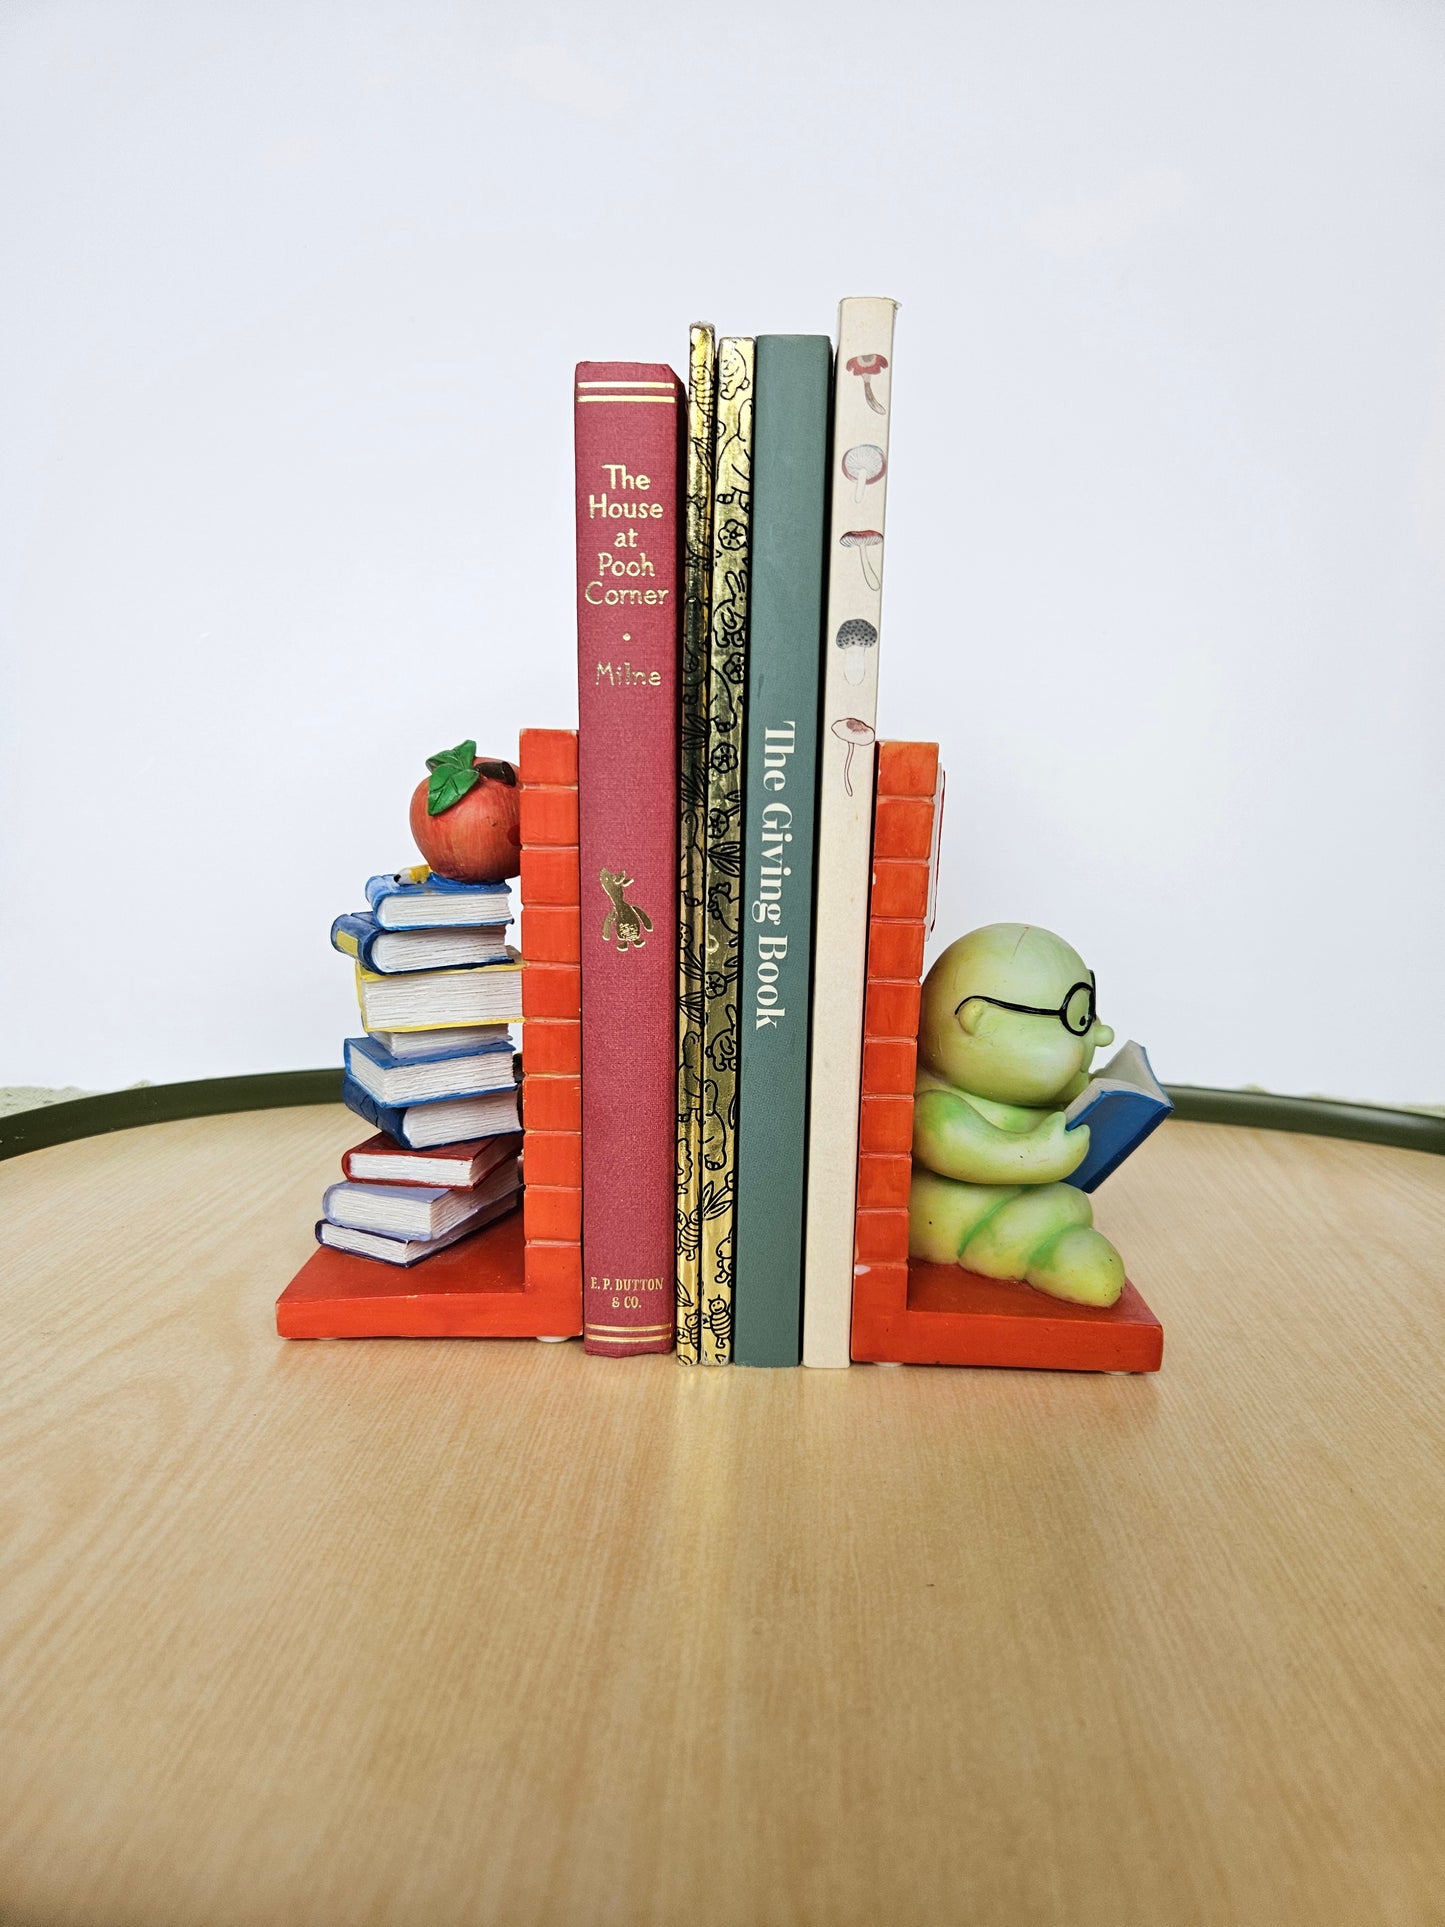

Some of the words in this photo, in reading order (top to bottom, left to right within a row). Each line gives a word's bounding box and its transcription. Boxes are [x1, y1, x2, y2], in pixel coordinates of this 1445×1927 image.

[601, 464, 650, 490] The
[588, 493, 664, 519] House
[614, 528, 638, 548] at
[598, 552, 655, 577] Pooh
[584, 581, 669, 605] Corner
[595, 662, 661, 686] Milne
[763, 720, 796, 791] The
[752, 802, 794, 926] Giving
[755, 934, 789, 1031] Book
[615, 1277, 664, 1291] DUTTON
[611, 1296, 620, 1308] &
[624, 1296, 642, 1309] CO.
